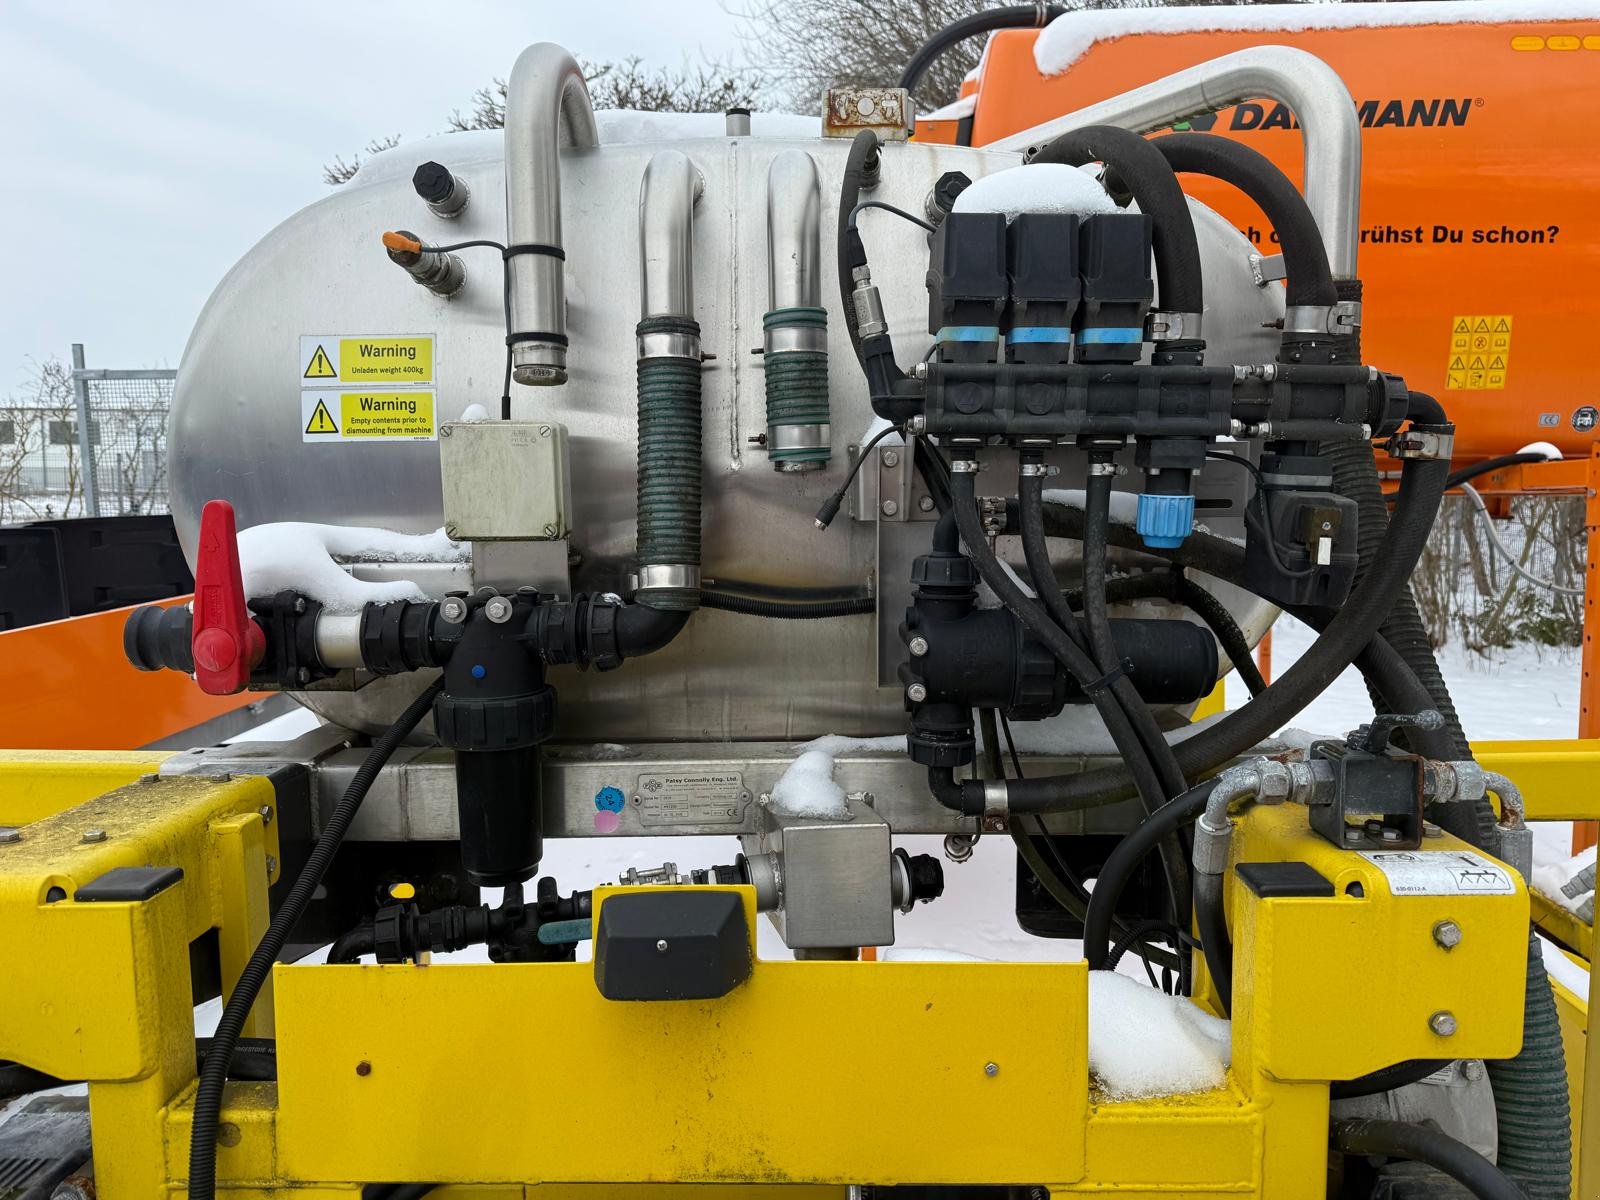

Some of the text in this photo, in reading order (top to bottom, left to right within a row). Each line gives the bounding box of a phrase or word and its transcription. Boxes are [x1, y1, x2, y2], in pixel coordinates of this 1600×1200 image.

[1229, 98, 1473, 131] DAMANN
[1360, 225, 1560, 243] rühst Du schon?
[359, 344, 417, 360] Warning
[351, 366, 424, 375] Unladen weight 400kg
[359, 397, 417, 413] Warning
[350, 417, 371, 425] Empty
[401, 417, 418, 425] prior
[346, 426, 432, 435] dismounting from machine
